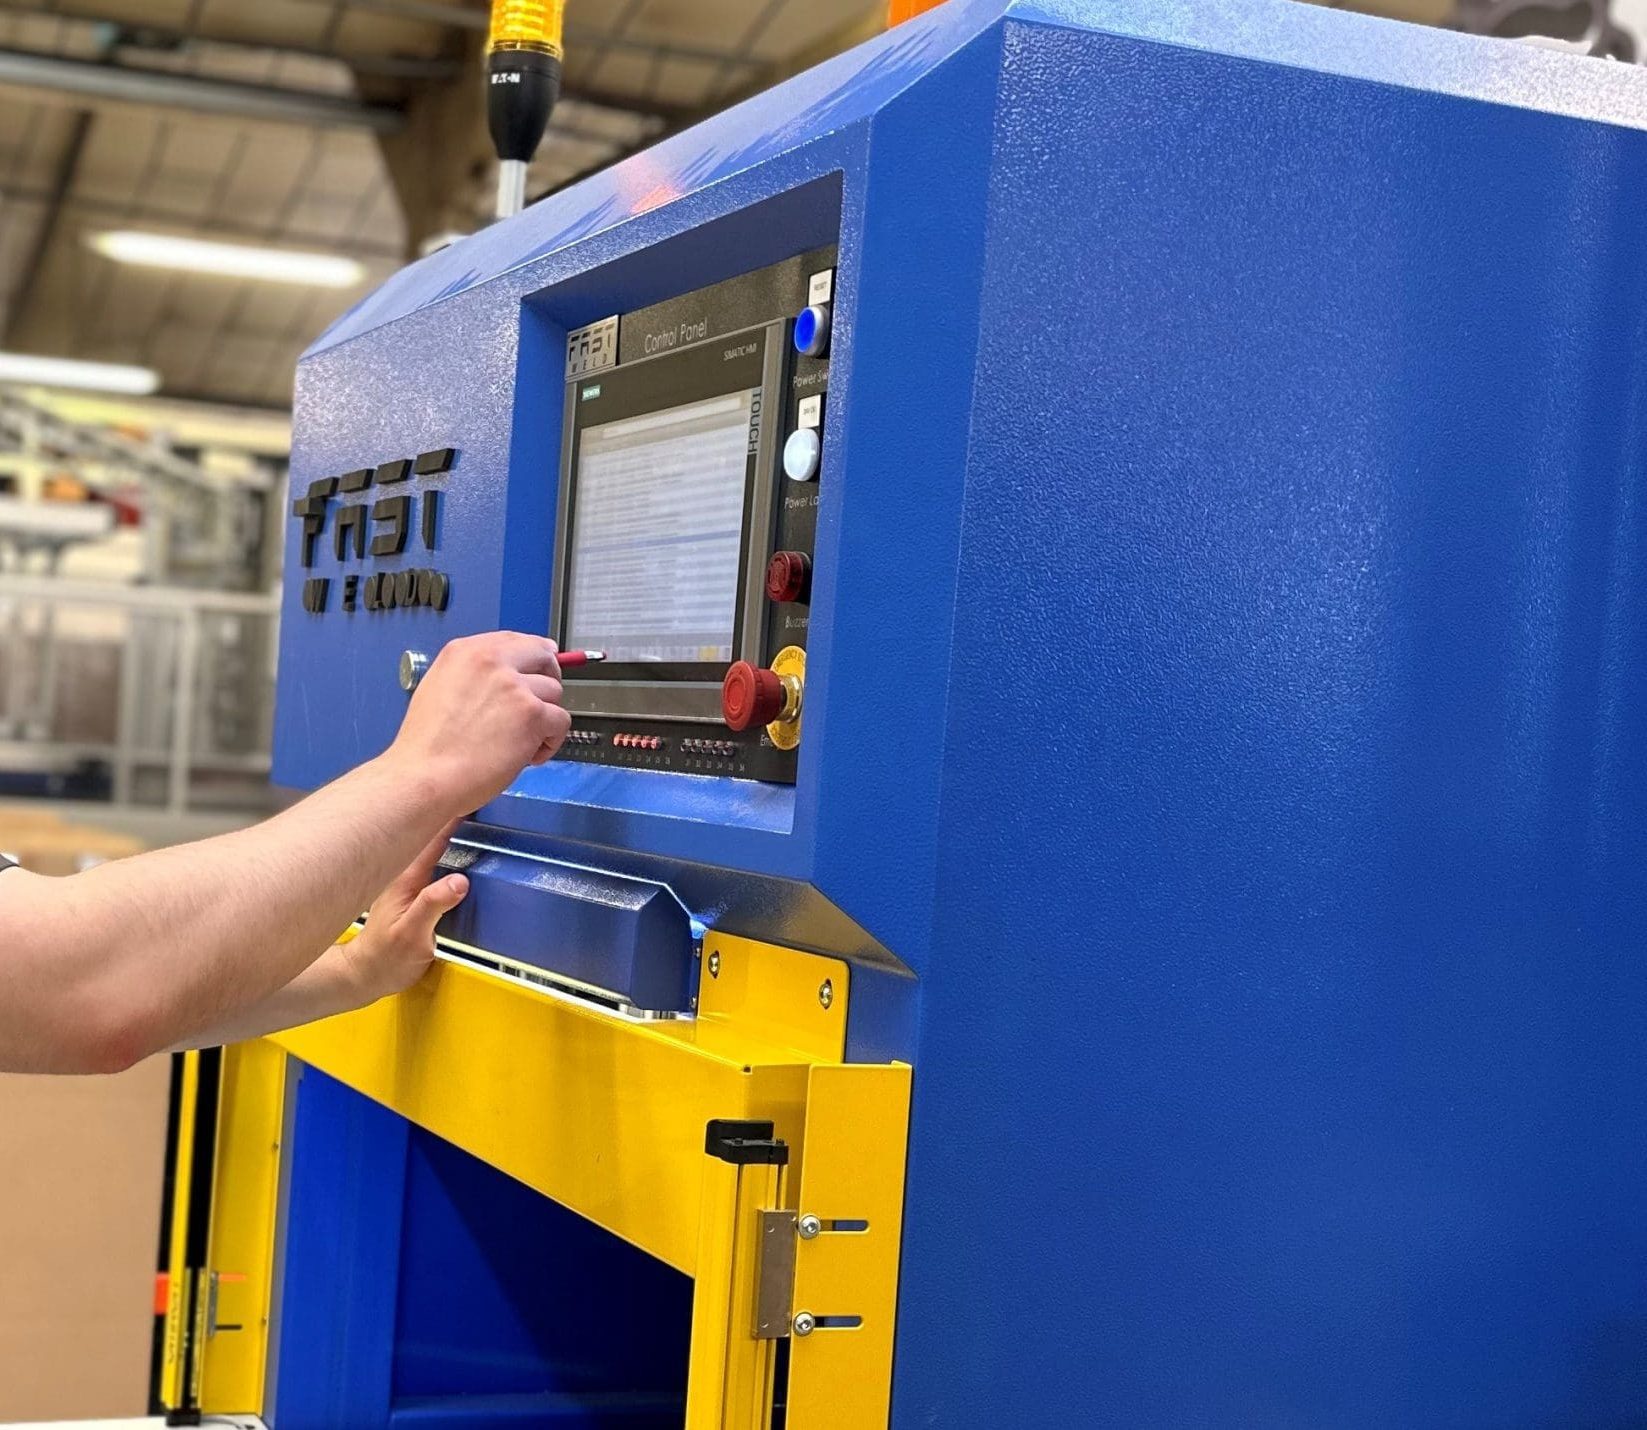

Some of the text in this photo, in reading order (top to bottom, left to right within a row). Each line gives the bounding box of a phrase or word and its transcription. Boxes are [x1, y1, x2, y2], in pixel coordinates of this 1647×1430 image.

[644, 316, 708, 354] Control Panel
[793, 373, 817, 388] Power
[748, 388, 762, 453] TOUCH
[784, 496, 808, 512] Power
